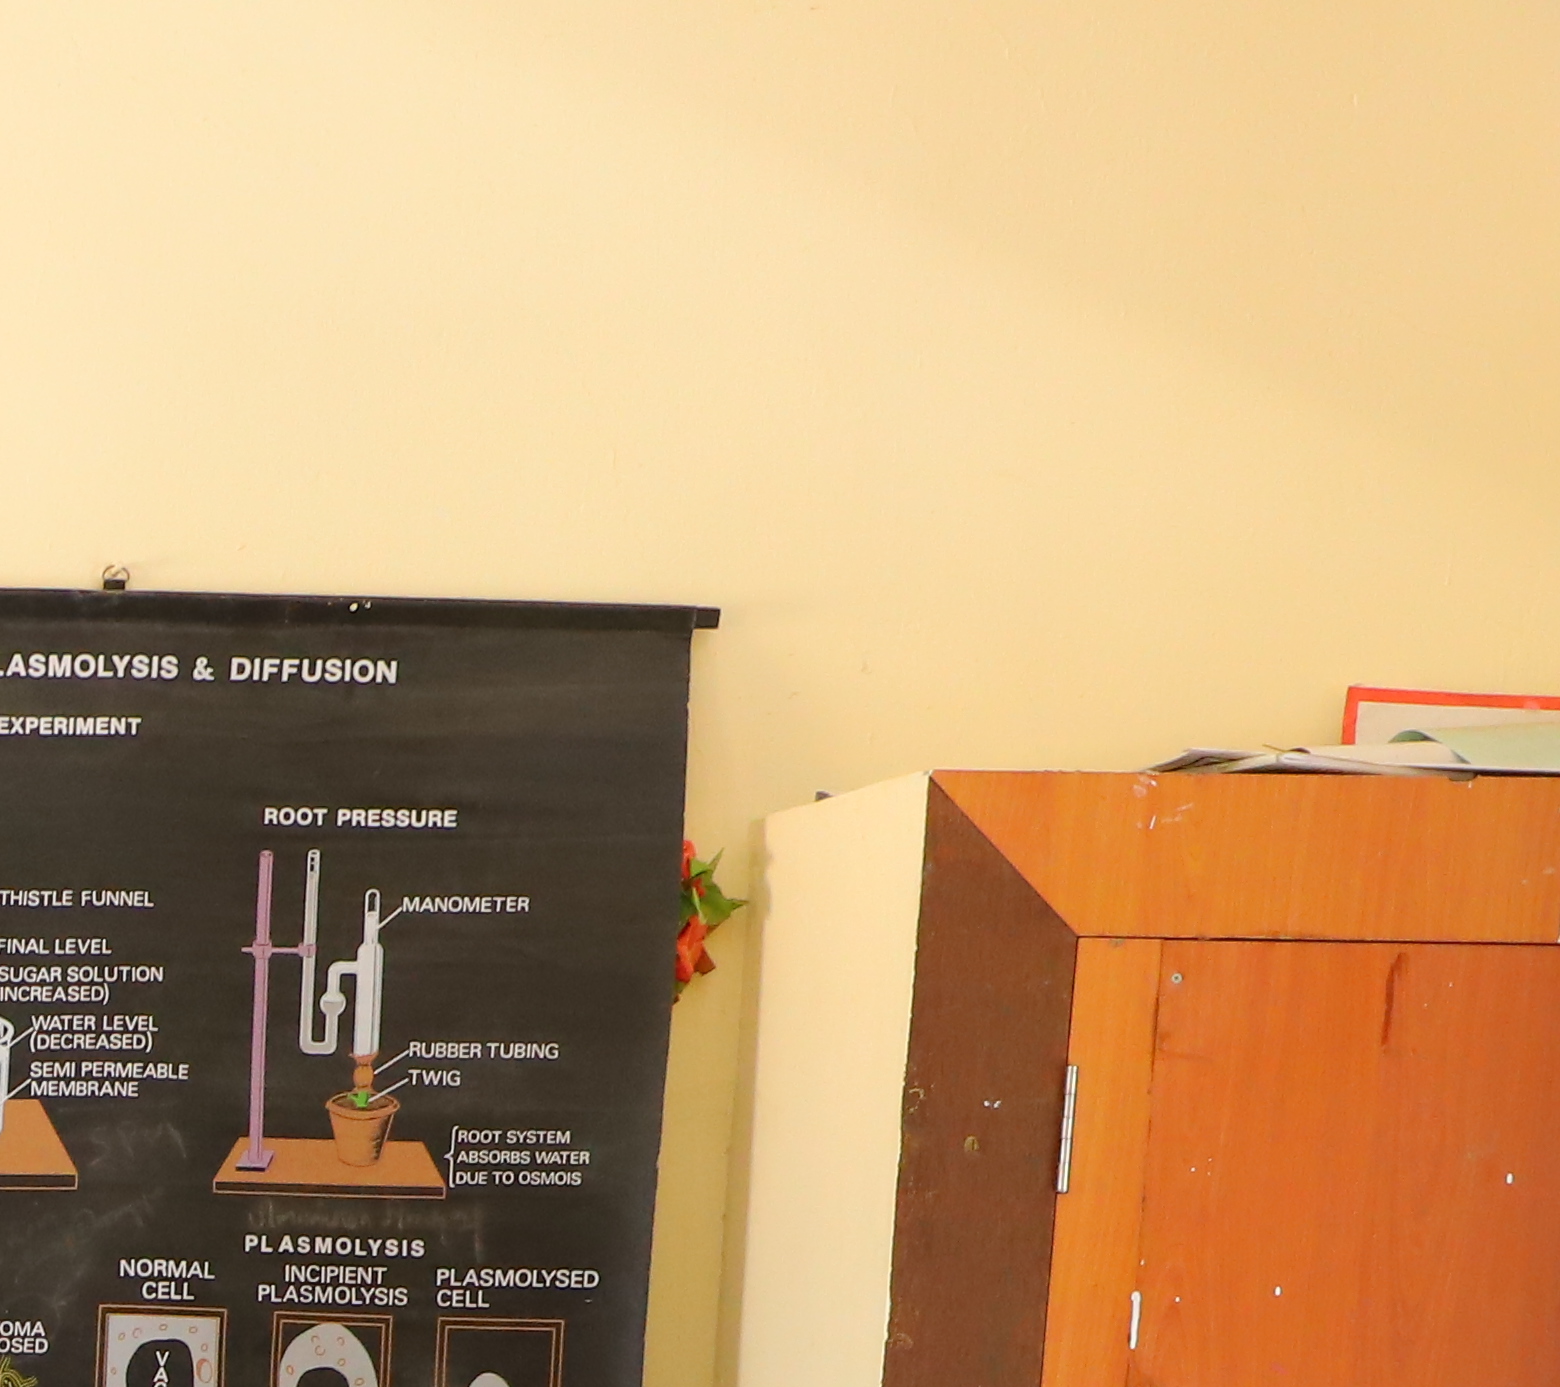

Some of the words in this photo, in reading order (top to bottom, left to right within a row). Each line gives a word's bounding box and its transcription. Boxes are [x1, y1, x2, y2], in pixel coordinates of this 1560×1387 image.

[192, 656, 215, 681] &
[229, 656, 398, 684] DIFFUSION
[263, 807, 328, 827] ROOT
[336, 808, 458, 828] PRESSURE
[80, 890, 154, 908] FUNNEL
[402, 896, 530, 913] MANOMETER
[54, 939, 112, 955] LEVEL
[66, 966, 164, 983] SOLUTION
[31, 1015, 96, 1031] WATER
[103, 1016, 158, 1031] LEVEL
[29, 1031, 154, 1053] (DECREASED)
[408, 1042, 482, 1059] RUBBER
[486, 1043, 559, 1060] TUBING
[30, 1061, 76, 1078] SEMI
[81, 1062, 190, 1080] PERMEABLE
[408, 1070, 461, 1087] TWIG
[30, 1081, 139, 1097] MEMBRANE
[457, 1130, 502, 1144] ROOT
[505, 1130, 571, 1145] SYSTEM
[457, 1150, 531, 1165] ABSORBS
[534, 1151, 590, 1165] WATER
[455, 1171, 488, 1185] DUE
[492, 1171, 515, 1185] TO
[518, 1170, 582, 1186] OSMOIS
[244, 1235, 426, 1258] PLASMOLYSIS
[119, 1258, 215, 1279] NORMAL
[284, 1264, 388, 1286] INCIPIENT
[436, 1269, 600, 1288] PLASMOLYSED
[141, 1281, 195, 1301] CELL
[257, 1284, 408, 1306] PLASMOLYSIS
[437, 1289, 490, 1309] CELL
